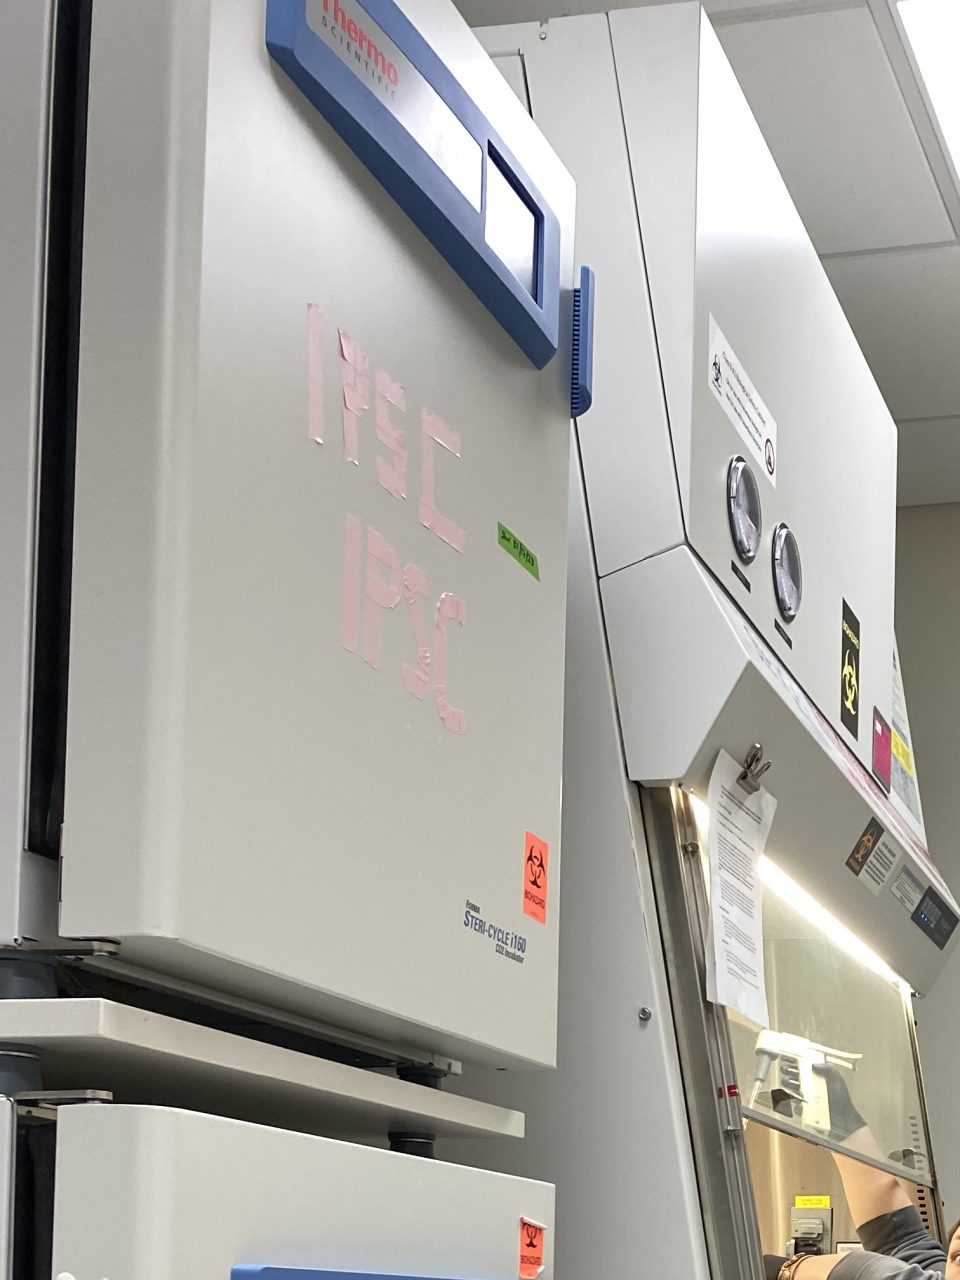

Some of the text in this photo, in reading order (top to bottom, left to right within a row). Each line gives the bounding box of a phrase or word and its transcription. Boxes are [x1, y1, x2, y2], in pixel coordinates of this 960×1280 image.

[322, 15, 396, 98] SCIENTIFIC
[464, 910, 527, 954] STERI-CYCLE i160
